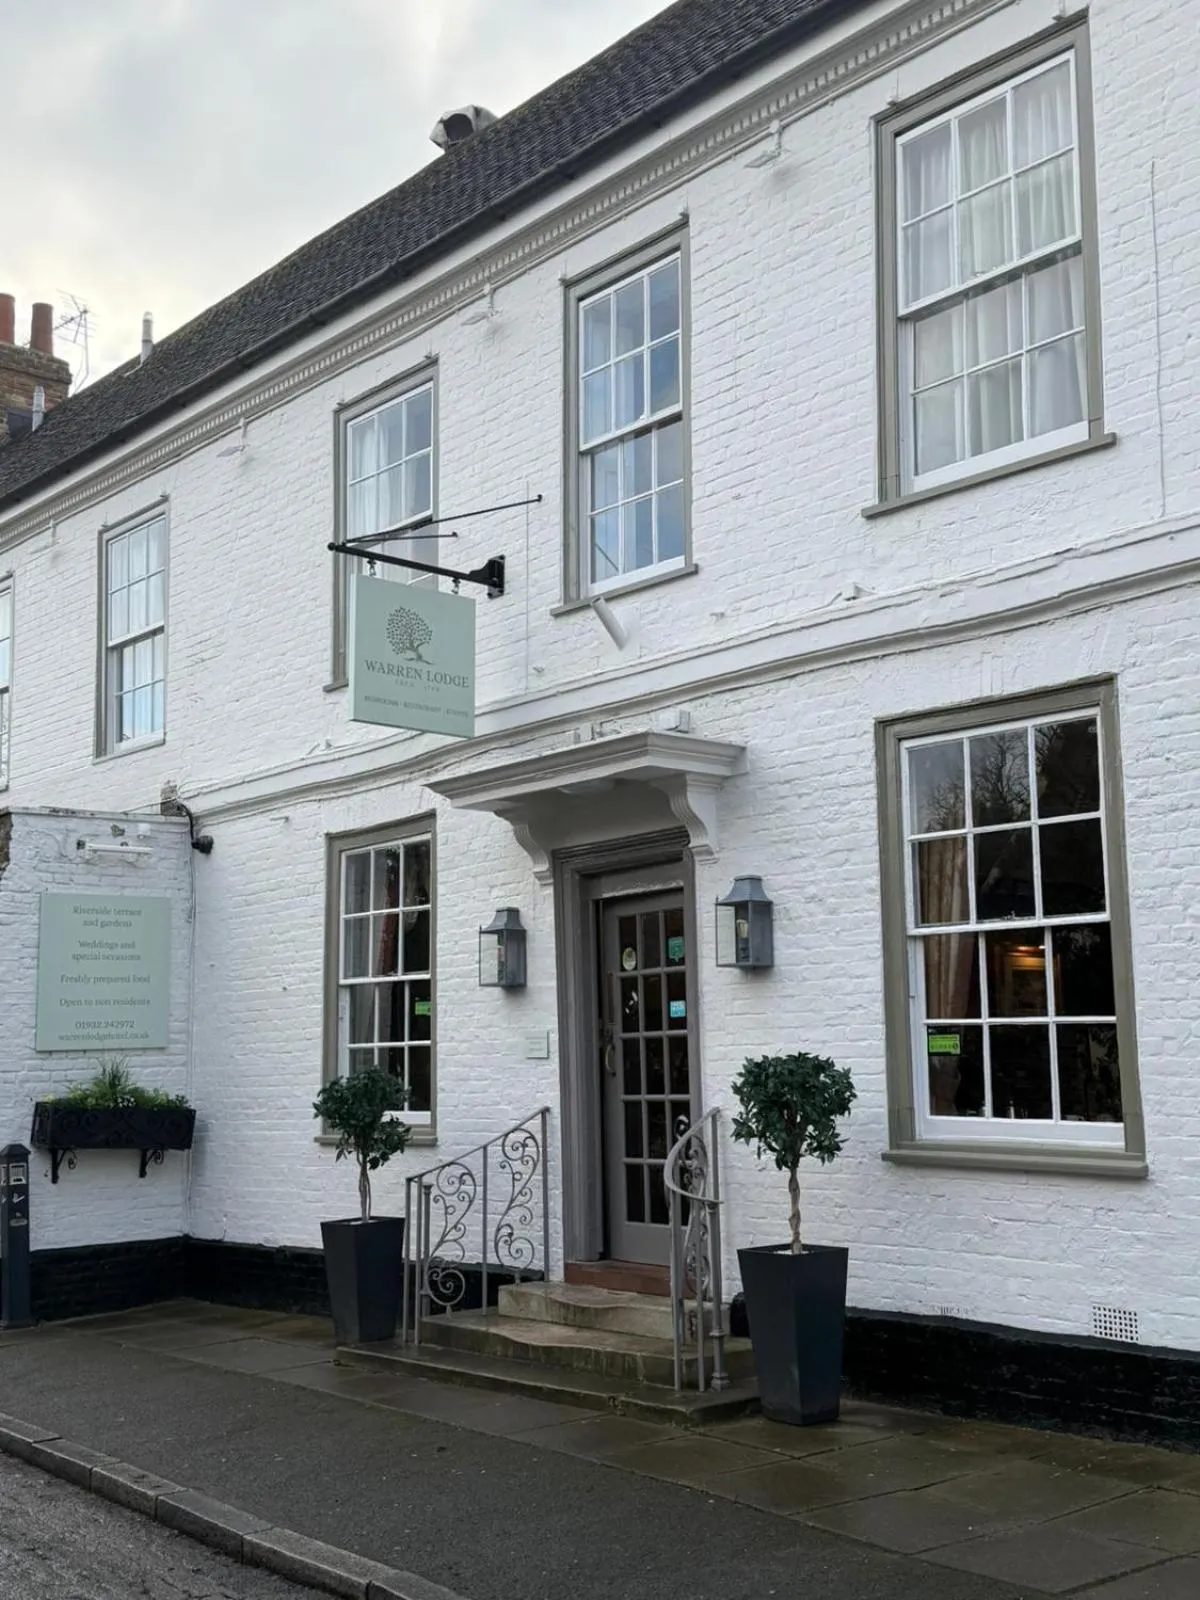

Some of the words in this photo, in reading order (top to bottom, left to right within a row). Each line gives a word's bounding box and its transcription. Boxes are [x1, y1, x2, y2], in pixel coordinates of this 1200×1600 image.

[364, 659, 423, 680] WARREN
[426, 670, 469, 688] LODGE
[72, 905, 111, 916] Riverside
[112, 907, 142, 917] terrace
[82, 918, 98, 927] and
[100, 918, 132, 928] gardens
[78, 940, 118, 950] Weddings
[120, 940, 136, 949] and
[72, 951, 100, 962] special
[102, 952, 141, 961] occasions
[60, 974, 91, 984] Freshly
[93, 974, 130, 984] prepared
[132, 974, 150, 983] food
[59, 998, 82, 1008] Open
[84, 998, 93, 1006] to
[95, 998, 112, 1006] non
[112, 997, 151, 1006] residents
